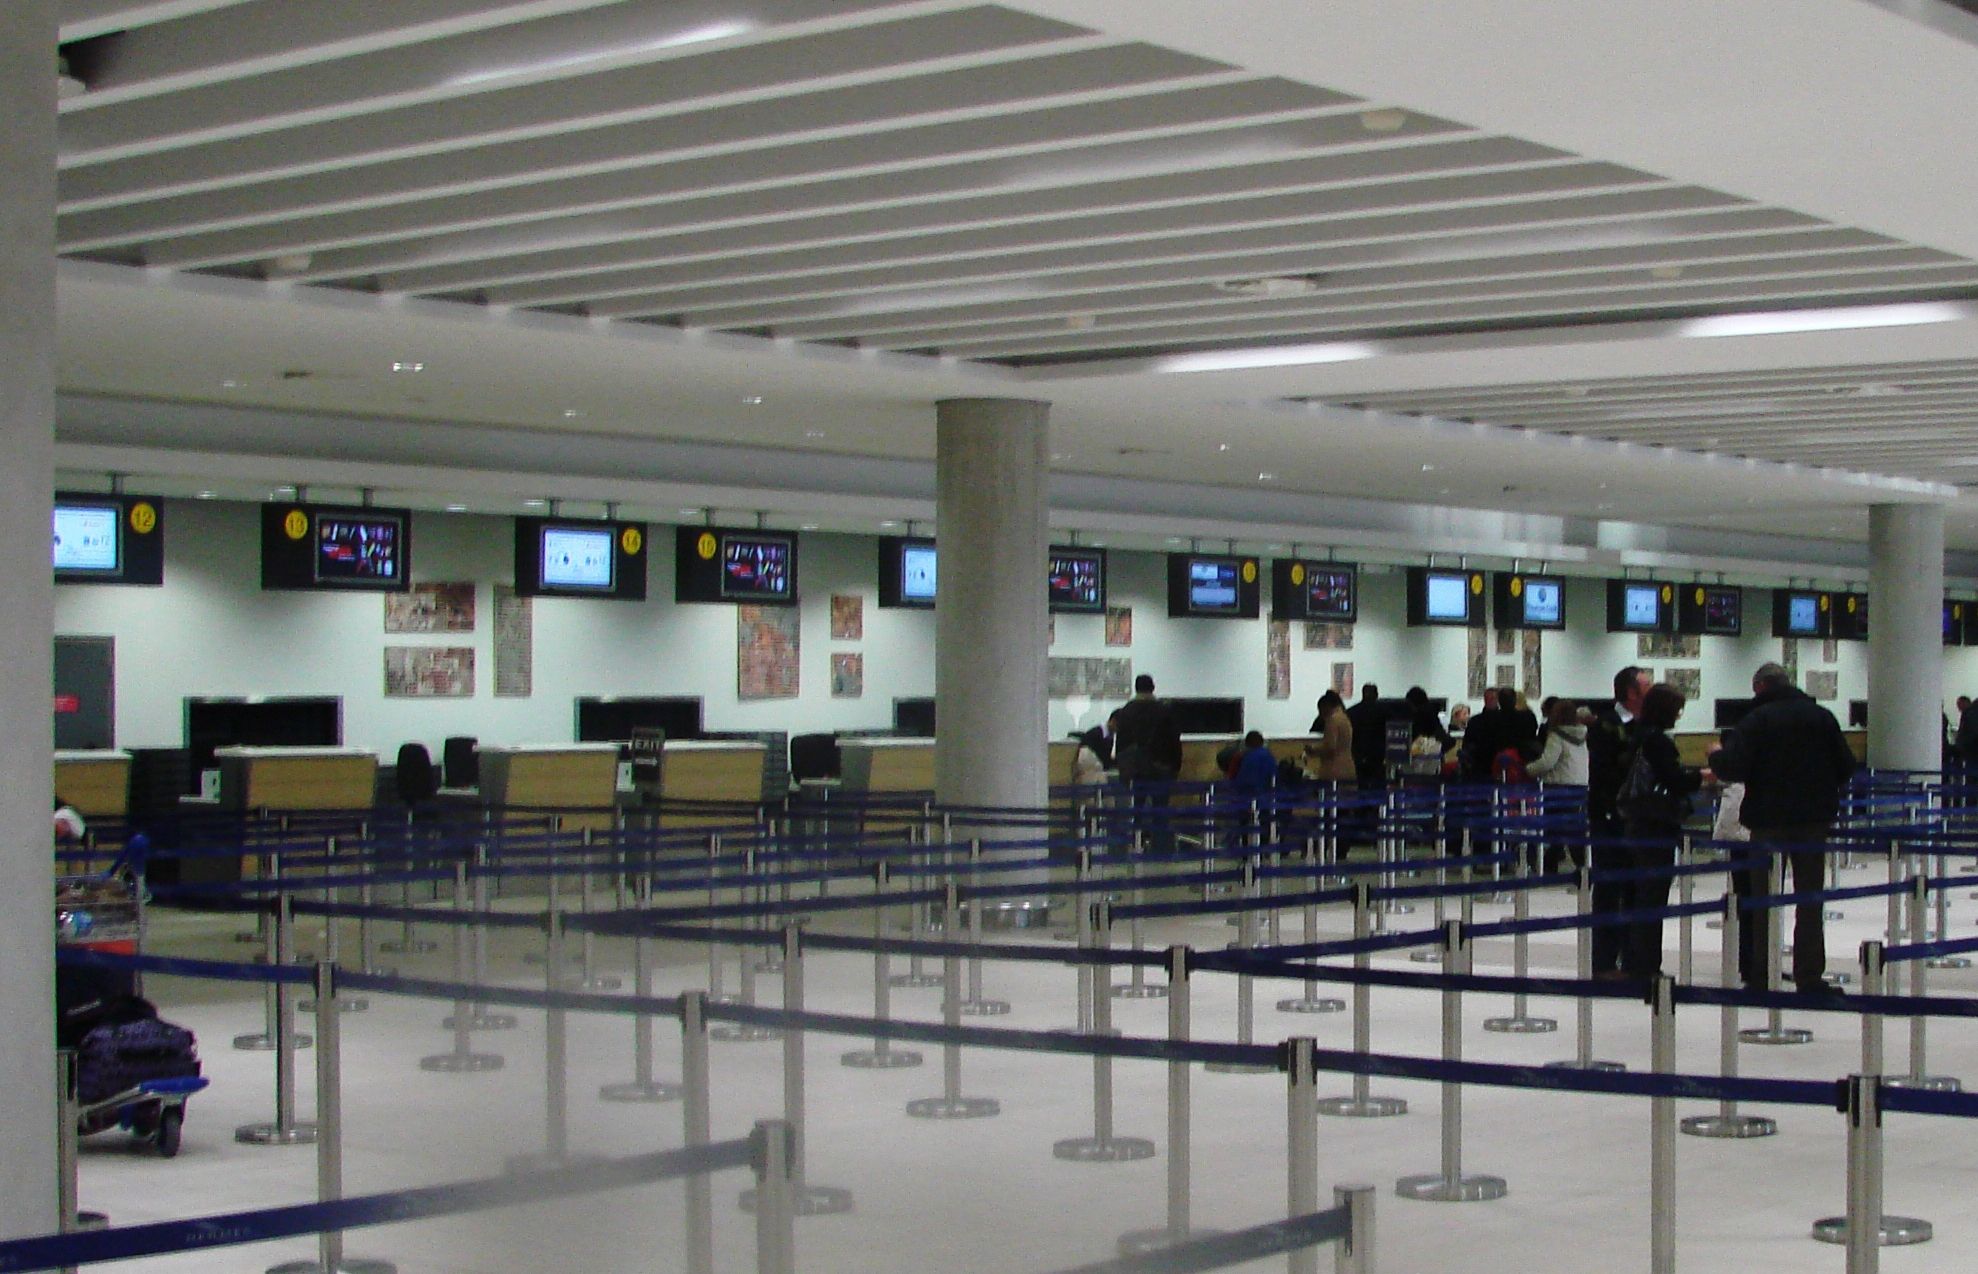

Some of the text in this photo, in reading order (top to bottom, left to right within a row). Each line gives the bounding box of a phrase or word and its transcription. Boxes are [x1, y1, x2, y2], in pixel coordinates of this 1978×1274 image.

[133, 509, 153, 527] 12
[289, 516, 306, 533] 13
[634, 739, 661, 751] EXIT
